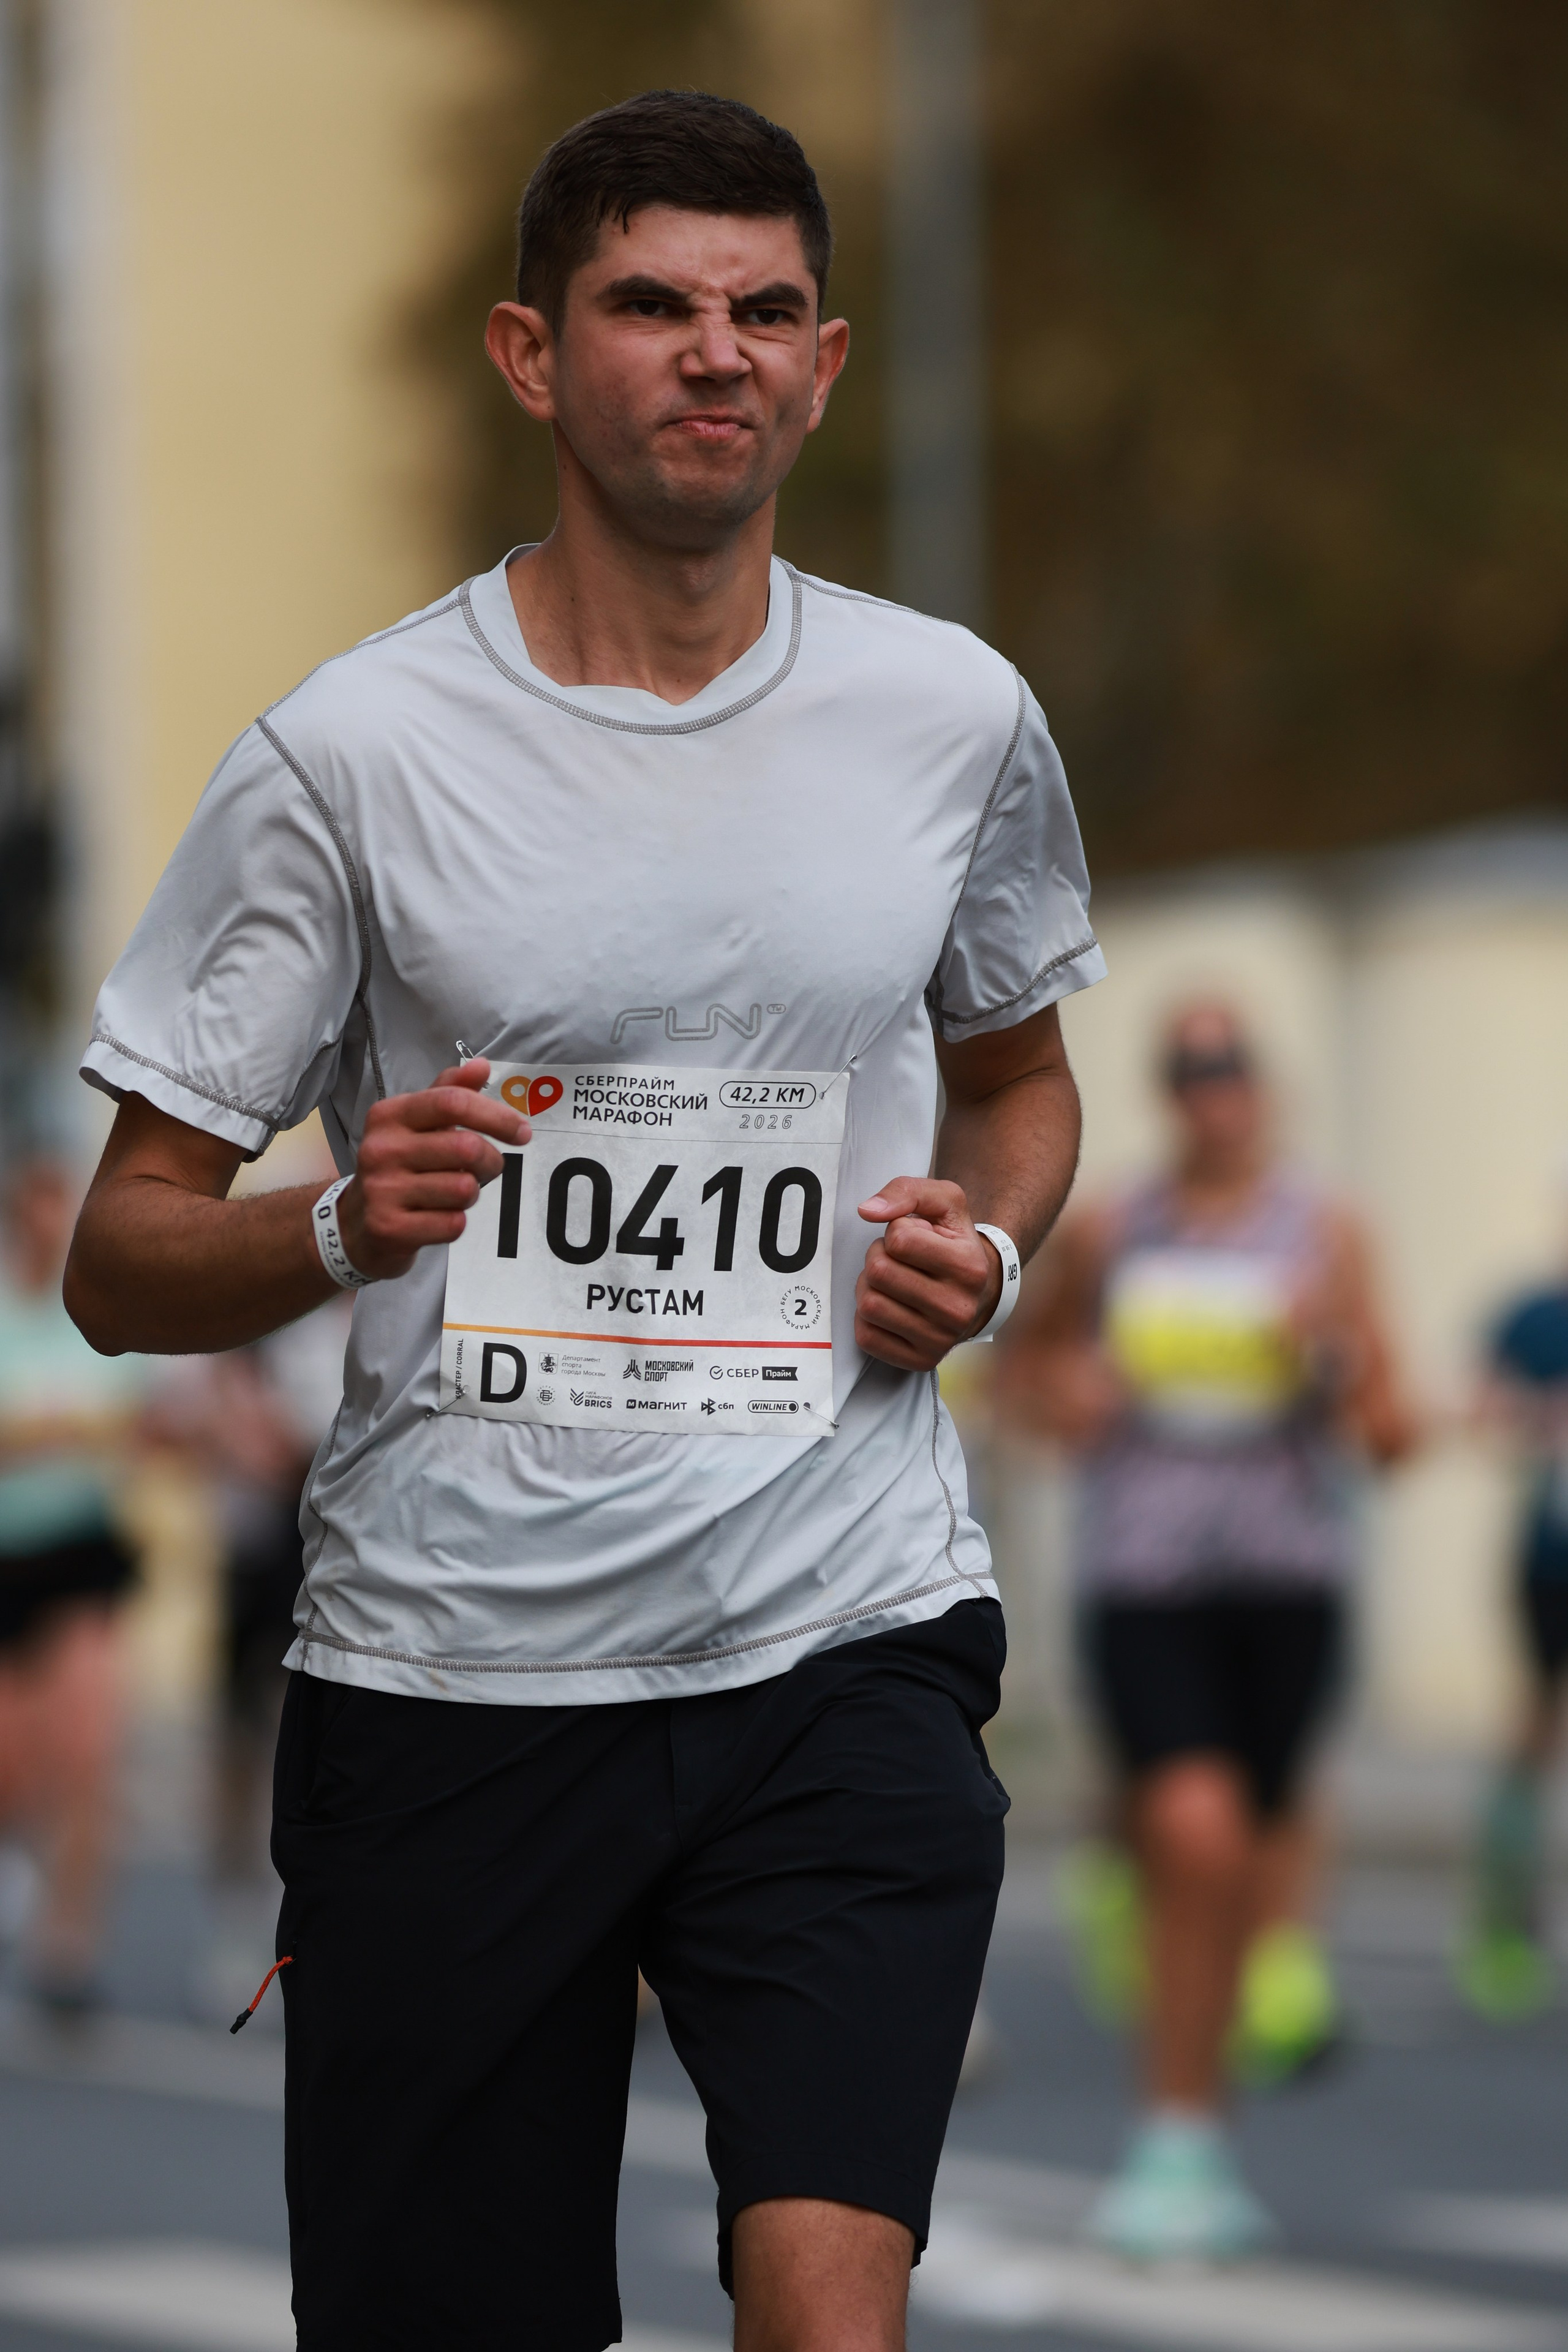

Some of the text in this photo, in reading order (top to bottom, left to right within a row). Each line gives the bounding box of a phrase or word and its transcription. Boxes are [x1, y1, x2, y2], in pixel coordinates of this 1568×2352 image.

[575, 1076, 674, 1090] СБЕРПРАЙМ
[574, 1089, 707, 1110] МОСКОВСКИЙ
[730, 1087, 770, 1104] 42,2
[573, 1106, 672, 1126] МАРАФОН
[739, 1114, 792, 1129] 2026
[479, 1153, 822, 1273] 10410
[587, 1284, 704, 1316] РУСТАМ
[780, 1286, 822, 1330] БЕГУ МОСКОВСКИЙ МАРАФОН
[794, 1298, 807, 1316] 2
[480, 1342, 527, 1403] D
[645, 1360, 693, 1371] МОСКОВСКИЙ
[726, 1368, 791, 1378] СБЕР Прайм
[644, 1371, 668, 1382] СПОРТ
[584, 1400, 612, 1408] BRICS
